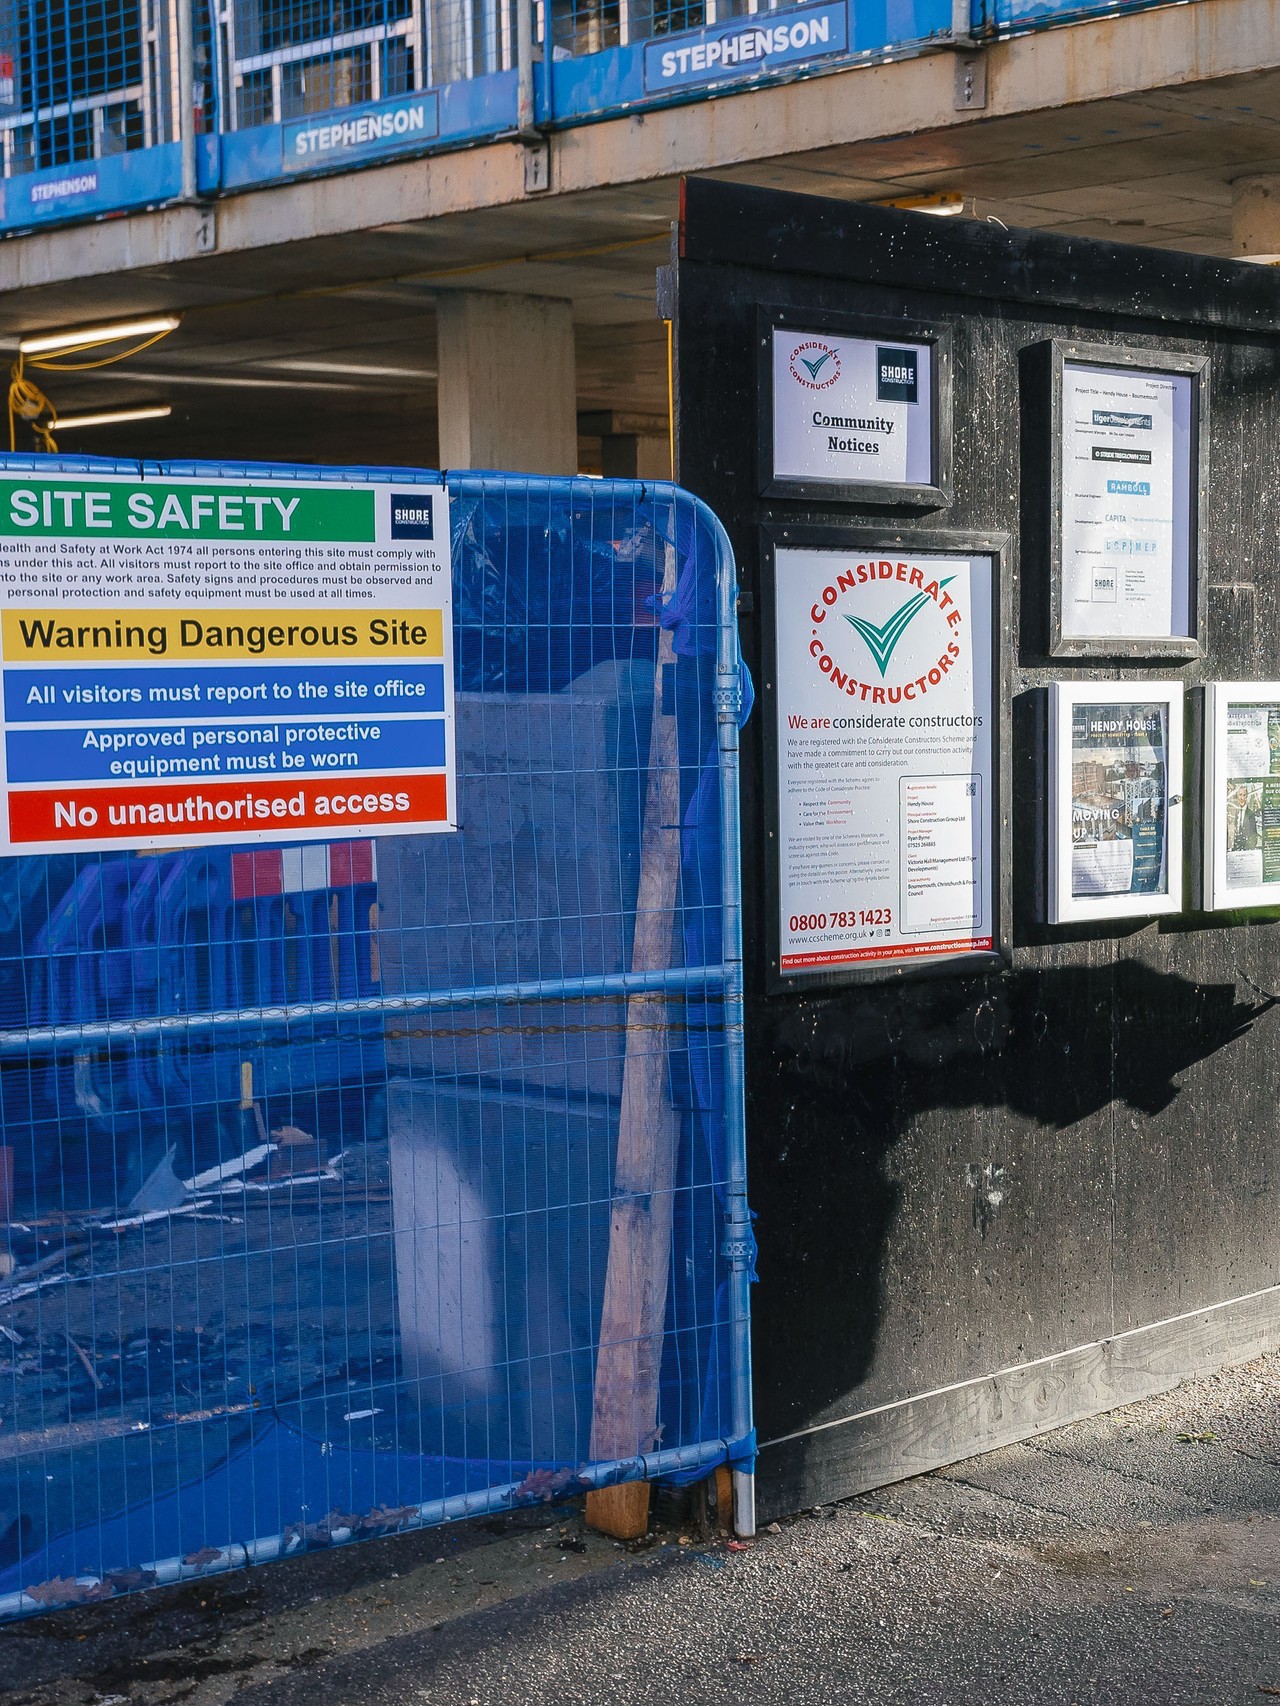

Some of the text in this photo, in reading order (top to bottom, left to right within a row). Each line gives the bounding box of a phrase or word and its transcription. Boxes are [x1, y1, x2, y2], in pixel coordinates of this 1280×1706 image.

[663, 16, 829, 78] STEPHENSON
[296, 105, 424, 155] STEPHENSON
[32, 174, 97, 202] STEPHENSON
[789, 341, 842, 367] CONSIDERATE
[789, 366, 841, 391] CONSTRUCTORS
[881, 377, 915, 385] CONSTRUCTION
[882, 365, 914, 380] SHORE
[1160, 383, 1178, 392] Directory
[812, 411, 895, 434] Community
[828, 436, 879, 453] Notices
[1111, 483, 1147, 493] RAMBOLL
[10, 490, 300, 531] SITE SAFETY
[395, 509, 429, 521] SHORE
[1105, 514, 1127, 522] CAPITA
[0, 542, 31, 552] ealth
[35, 544, 56, 553] and
[60, 543, 95, 554] Safety
[99, 544, 110, 554] at
[113, 544, 142, 554] Work
[145, 545, 164, 554] Act
[167, 545, 192, 555] 1974
[196, 545, 208, 555] all
[212, 547, 255, 556] persons
[258, 548, 301, 558] entering
[304, 547, 323, 557] this
[327, 548, 345, 557] site
[376, 548, 412, 560] comply
[415, 548, 435, 558] with
[14, 559, 48, 567] under
[51, 558, 72, 568] this
[76, 560, 96, 568] act.
[100, 559, 115, 568] All
[118, 559, 160, 569] visitors
[163, 561, 190, 569] must
[194, 561, 226, 569] report
[230, 560, 242, 569] to
[244, 560, 259, 570] the
[263, 560, 282, 570] site
[285, 561, 313, 570] office
[317, 561, 337, 570] and
[340, 561, 372, 571] obtain
[374, 562, 430, 572] permission
[432, 562, 441, 571] to
[19, 572, 37, 582] the
[42, 572, 62, 582] site
[66, 574, 78, 582] or
[81, 574, 101, 584] any
[136, 575, 163, 583] area.
[167, 573, 201, 583] Safety
[204, 575, 233, 585] signs
[237, 574, 258, 583] and
[260, 576, 318, 584] procedures
[322, 576, 347, 584] must
[350, 575, 362, 584] be
[414, 575, 433, 585] and
[7, 588, 58, 597] personal
[62, 588, 120, 597] protection
[124, 588, 144, 597] and
[148, 588, 181, 597] safety
[184, 589, 241, 597] equipment
[274, 588, 286, 597] be
[318, 589, 327, 597] at
[330, 588, 342, 598] all
[345, 589, 375, 598] times.
[810, 560, 962, 628] CONSIDERATE
[19, 618, 428, 654] Warning Dangerous Site
[809, 638, 960, 704] CONSTRUCTORS
[26, 680, 425, 704] All visitors must report to the site office
[788, 714, 983, 729] We are considerate constructors
[1090, 721, 1123, 731] HENDY
[1126, 720, 1156, 731] HOUSE
[83, 724, 380, 748] Approved personal protective
[810, 738, 841, 747] registered
[857, 737, 867, 745] the
[868, 737, 903, 745] Considerate
[803, 750, 821, 758] made
[828, 749, 867, 757] commitment
[875, 749, 890, 757] carry
[891, 747, 902, 755] out
[914, 747, 951, 755] construction
[952, 746, 973, 754] activity
[110, 752, 358, 774] equipment must be worn
[788, 761, 802, 769] with
[814, 761, 840, 770] greatest
[868, 759, 908, 767] consideration.
[54, 791, 410, 828] No unauthorised access
[1073, 809, 1120, 822] MOVING
[790, 908, 892, 932] 0800 783 1423
[788, 931, 867, 944] www.ccscheme.org.uk
[831, 952, 859, 960] construction
[860, 950, 876, 958] activity
[882, 950, 893, 958] your
[914, 939, 989, 952] www.constructionmap.info
